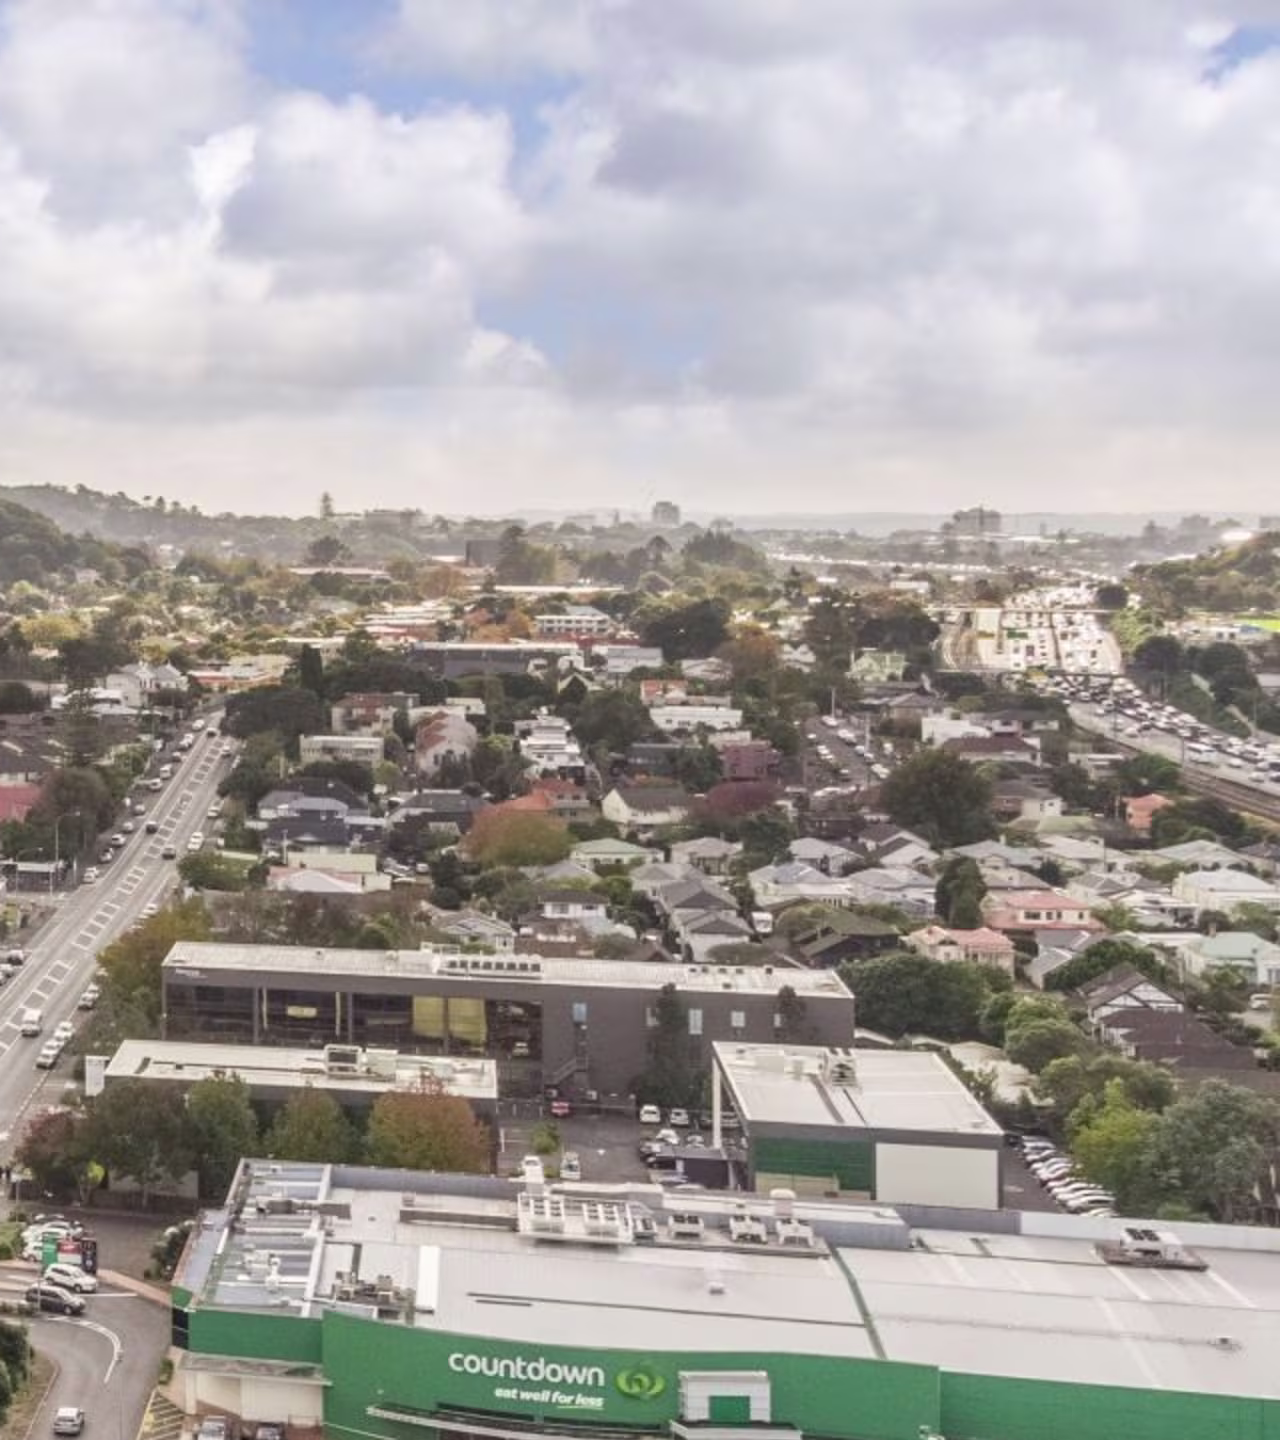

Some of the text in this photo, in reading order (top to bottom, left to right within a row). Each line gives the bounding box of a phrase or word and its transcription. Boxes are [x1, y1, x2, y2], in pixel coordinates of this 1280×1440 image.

[448, 1353, 605, 1387] countdown
[494, 1387, 604, 1408] eat well for less
